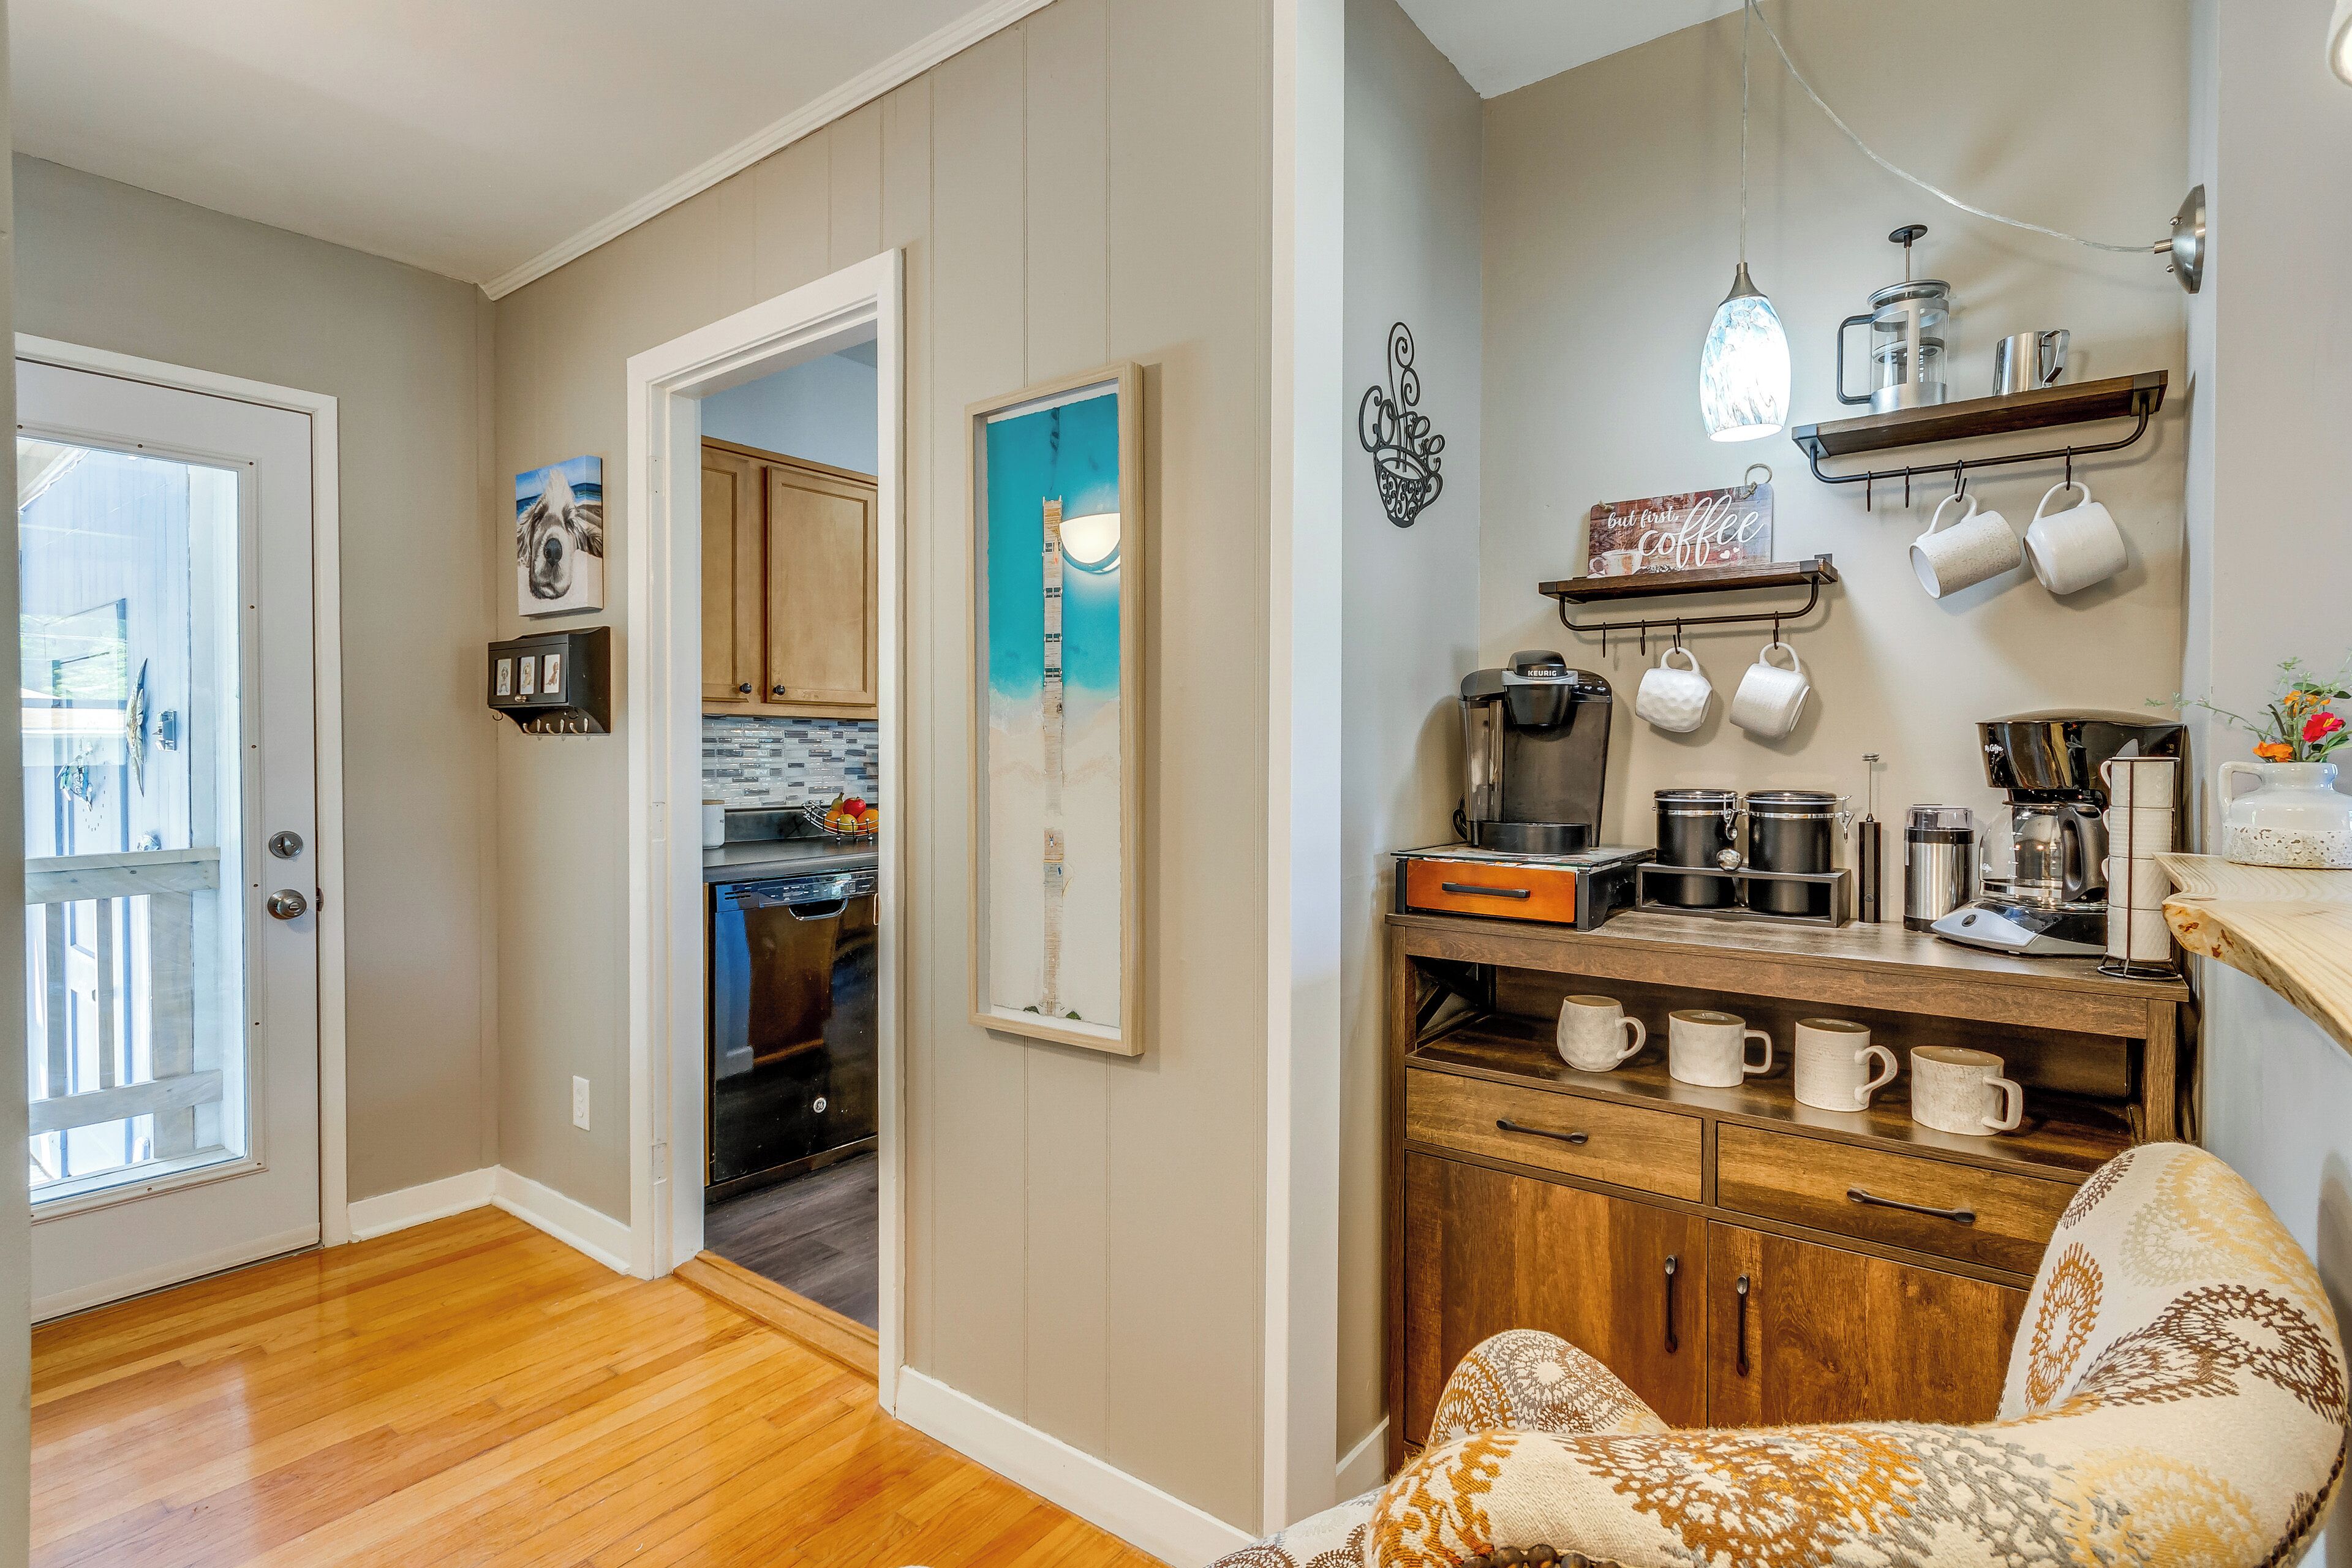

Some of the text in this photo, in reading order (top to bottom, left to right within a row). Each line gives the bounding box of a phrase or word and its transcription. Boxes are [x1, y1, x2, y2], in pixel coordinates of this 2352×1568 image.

[1608, 505, 1679, 529] but first,
[1638, 495, 1764, 568] coffee
